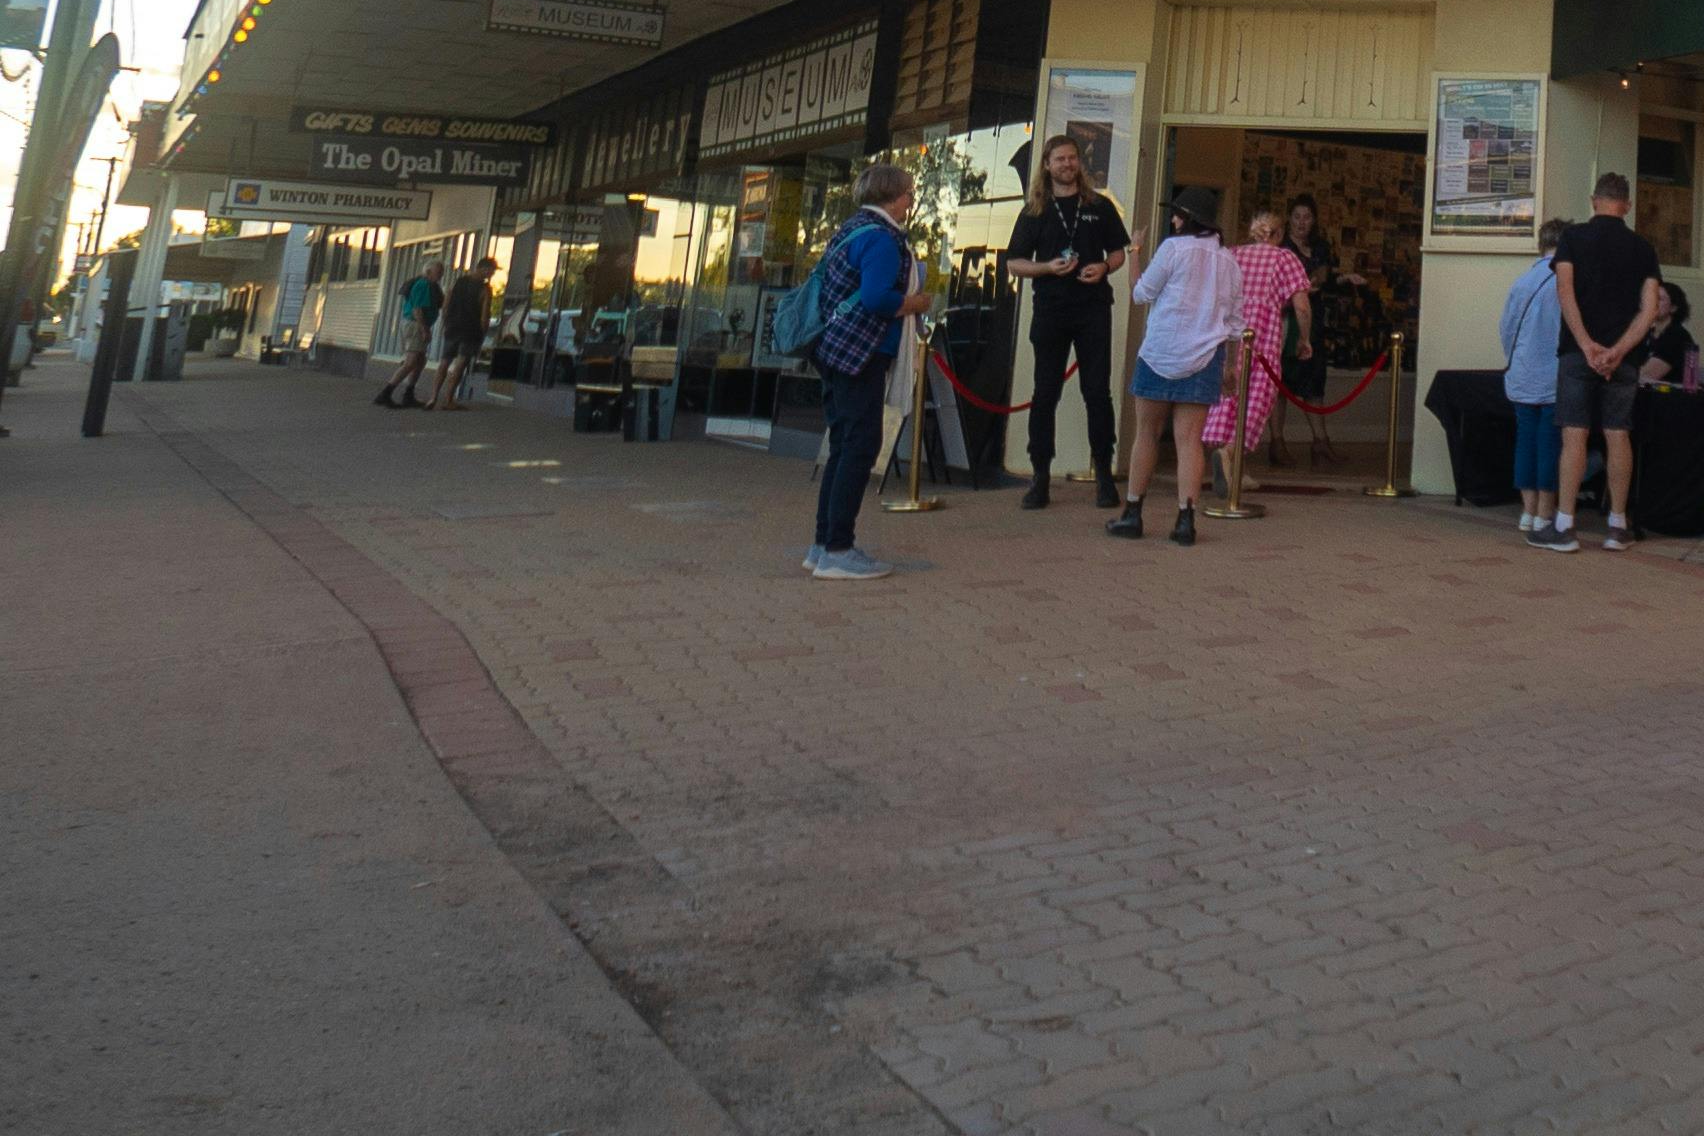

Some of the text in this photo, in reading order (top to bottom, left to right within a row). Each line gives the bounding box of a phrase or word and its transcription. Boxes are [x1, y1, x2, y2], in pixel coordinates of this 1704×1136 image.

[538, 6, 632, 33] MUSEUM
[721, 53, 848, 130] MUSEUM
[304, 111, 549, 144] GIFTS GEMS SOUVENIRS
[321, 142, 373, 171] The
[380, 146, 443, 179] Opal
[449, 151, 523, 178] Miner
[268, 188, 414, 211] WINTON PHARMACY
